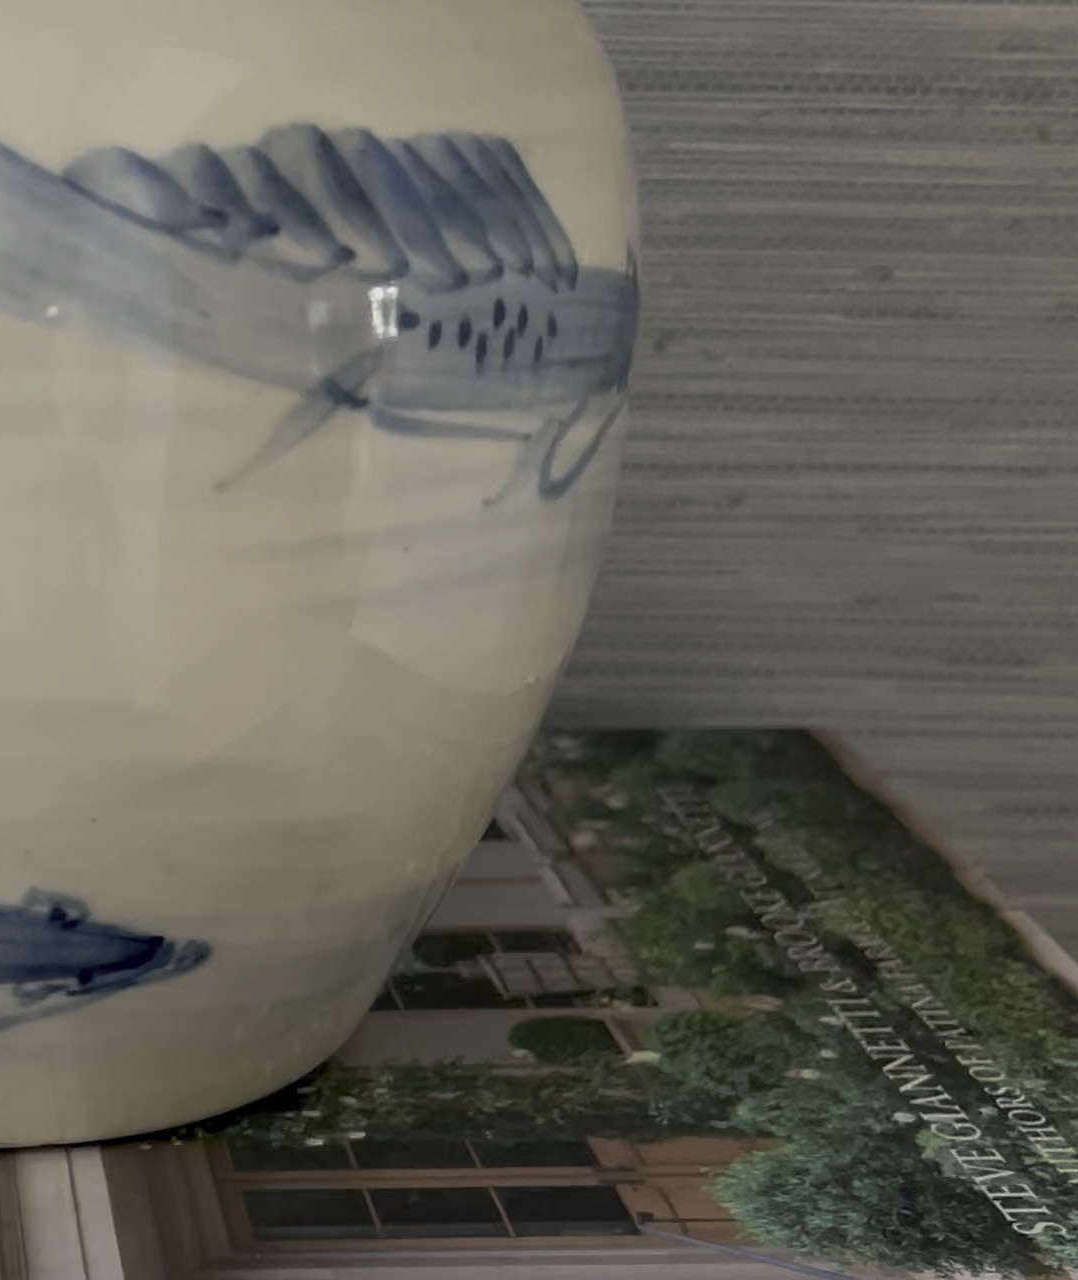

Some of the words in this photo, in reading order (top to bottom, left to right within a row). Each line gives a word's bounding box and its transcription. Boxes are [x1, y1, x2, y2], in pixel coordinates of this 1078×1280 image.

[826, 997, 983, 1142] GIANNETTI
[956, 1054, 1005, 1082] OF
[984, 1086, 1078, 1183] UTHORS
[950, 1148, 1068, 1236] STEVE
